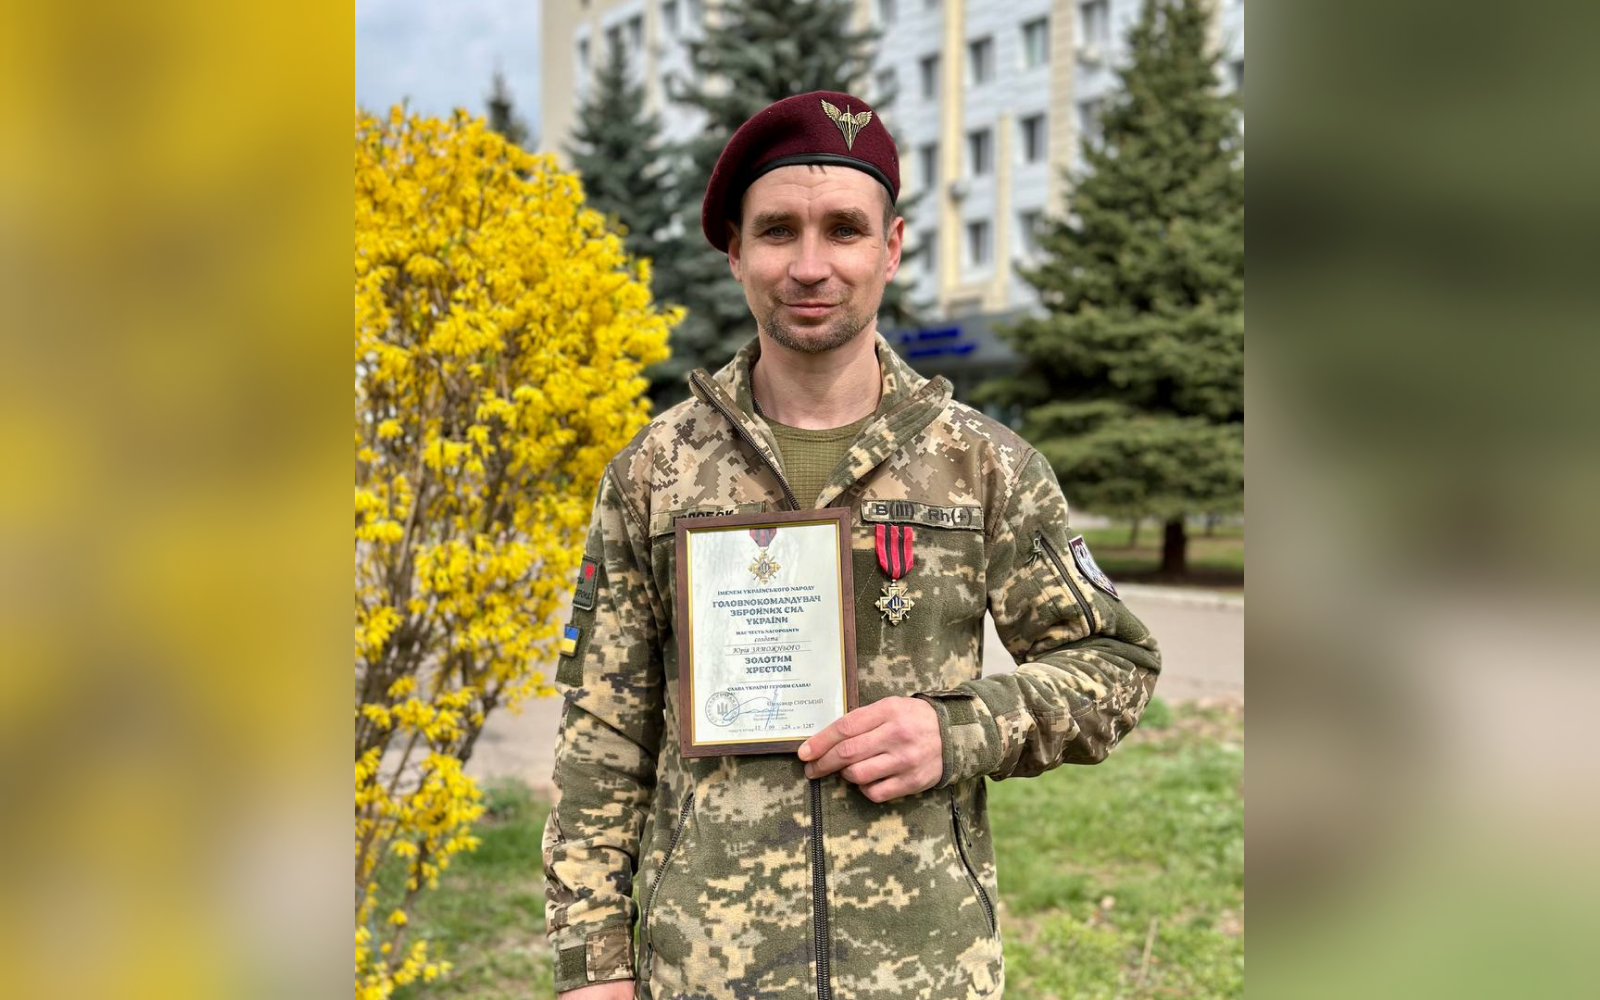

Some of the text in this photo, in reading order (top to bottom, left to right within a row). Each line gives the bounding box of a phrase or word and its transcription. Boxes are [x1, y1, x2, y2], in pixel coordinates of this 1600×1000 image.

[928, 508, 973, 527] Rh(+)
[743, 586, 790, 595] УКРАЇНСЬКОГО
[712, 595, 821, 608] ГОЛОВНОКОМАНДУВАЧ
[730, 606, 804, 617] ЗБРОЙНИХ СИЛ
[746, 616, 789, 626] УКРАЇНИ
[745, 655, 792, 665] ЗОЛОТИМ
[746, 665, 792, 674] ХРЕСТОМ
